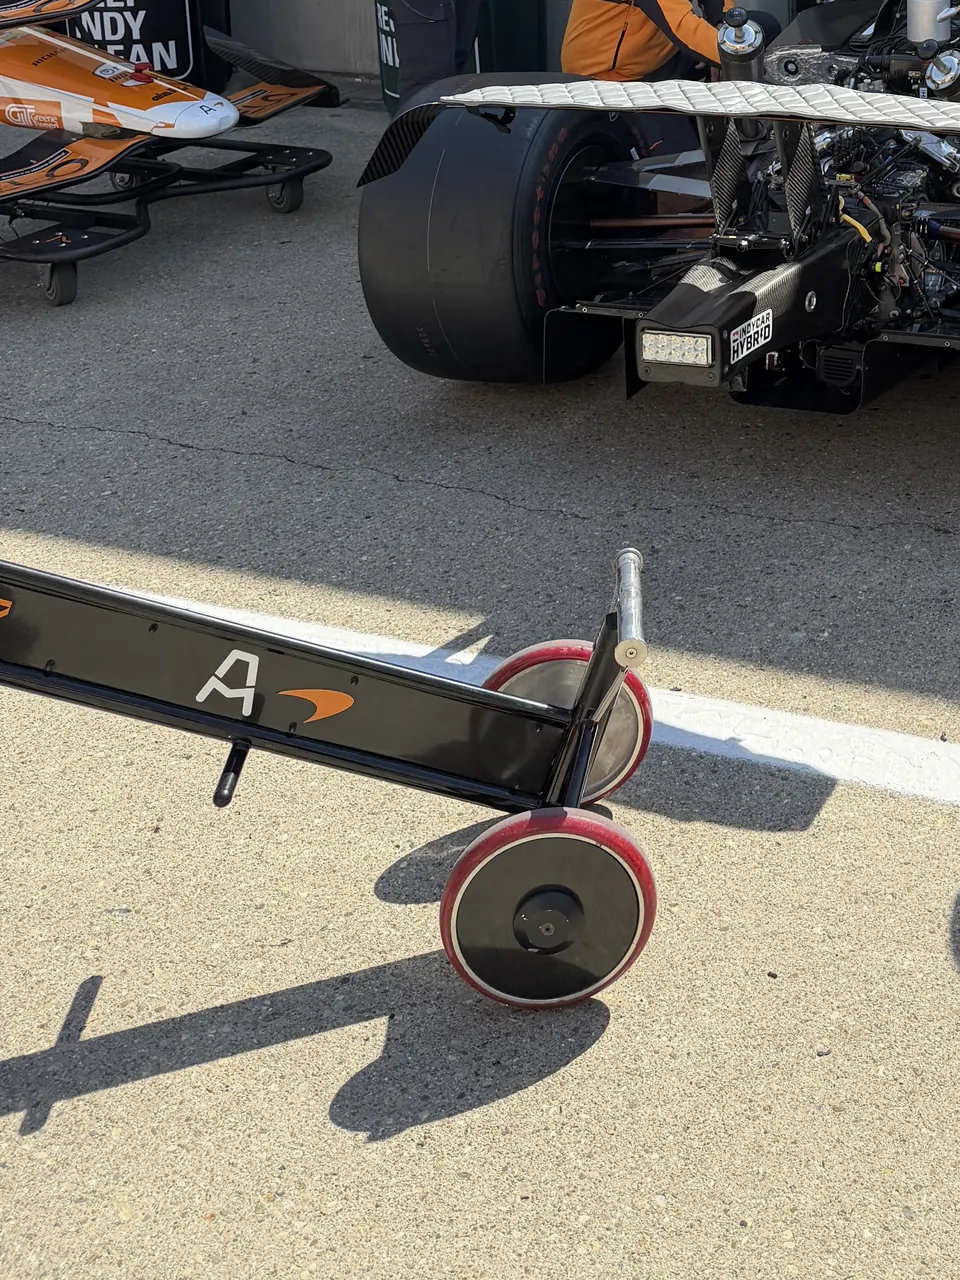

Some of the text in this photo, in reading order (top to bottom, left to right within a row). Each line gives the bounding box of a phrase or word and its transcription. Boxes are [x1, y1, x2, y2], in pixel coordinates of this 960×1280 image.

[199, 104, 217, 115] A
[739, 312, 770, 339] INDYCAR
[732, 323, 771, 361] HYBRID
[195, 649, 259, 716] A
